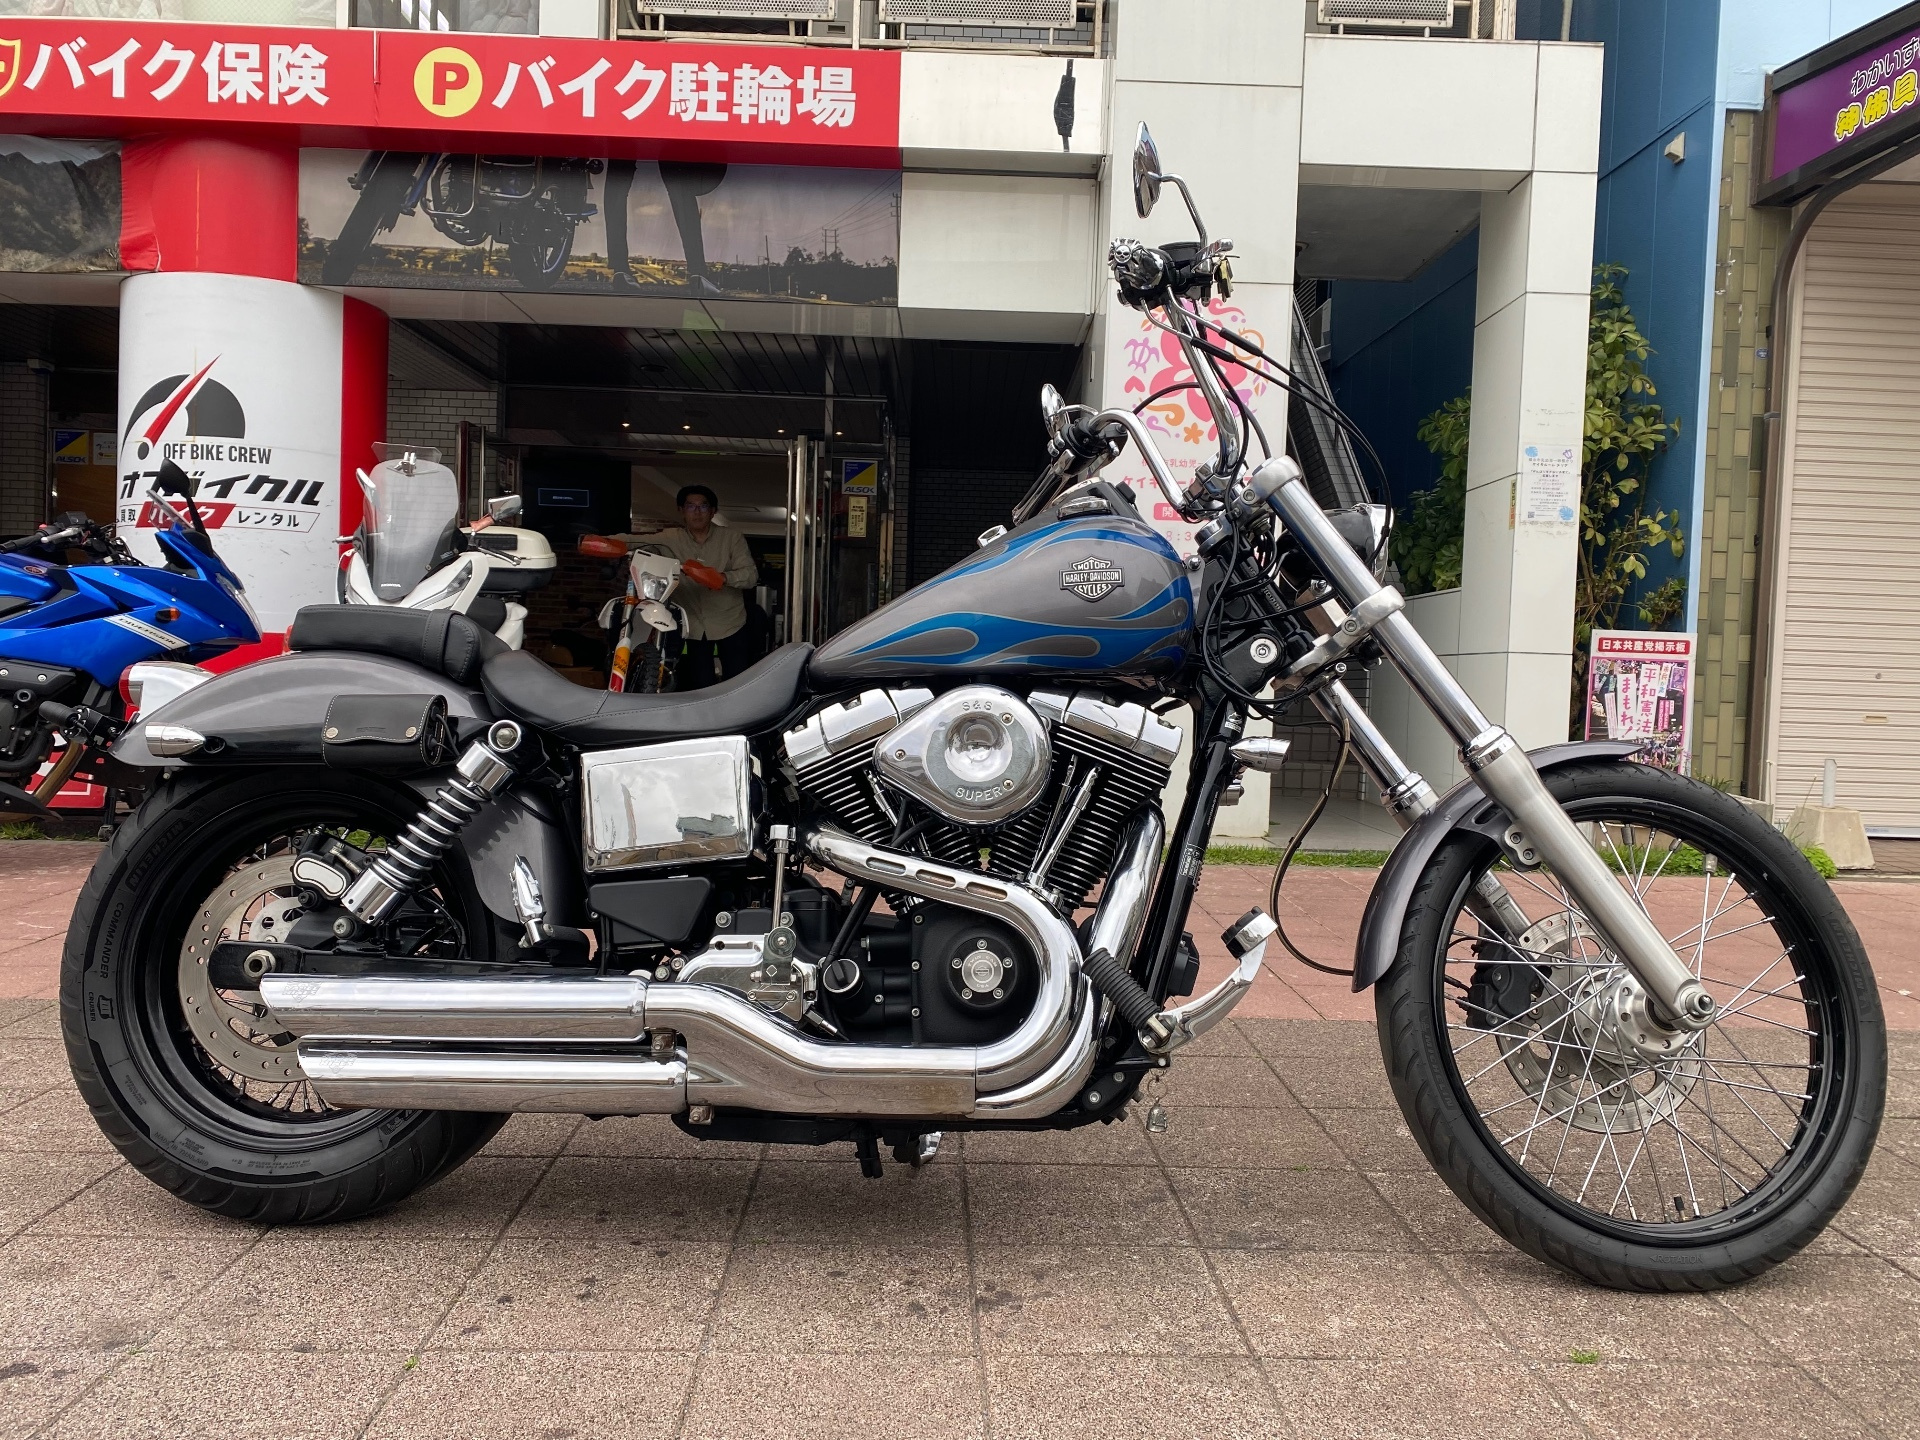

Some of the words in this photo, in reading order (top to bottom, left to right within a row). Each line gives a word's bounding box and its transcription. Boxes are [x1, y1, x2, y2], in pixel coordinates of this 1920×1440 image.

[23, 36, 329, 106] バイク保険
[1850, 37, 1920, 96] わかいず
[432, 61, 471, 106] P
[492, 55, 857, 128] バイク駐輪場
[56, 455, 87, 464] ALSOK
[163, 443, 187, 460] OFF
[190, 444, 224, 461] BIKE
[229, 445, 272, 464] CREW
[843, 486, 875, 494] ALSOK
[238, 510, 300, 528] レンタル
[1077, 560, 1106, 571] MOTOR
[1065, 571, 1119, 583] HARLEY-DAVIDSON
[1078, 583, 1107, 596] CYCLES
[1602, 640, 1687, 652] 日本共産党掲示板
[1636, 667, 1657, 734] 平和憲法
[954, 786, 1002, 802] SUPER
[100, 901, 125, 979] COMMANDER
[87, 991, 97, 1022] CRUISER
[1657, 1254, 1704, 1264] ROTATION
